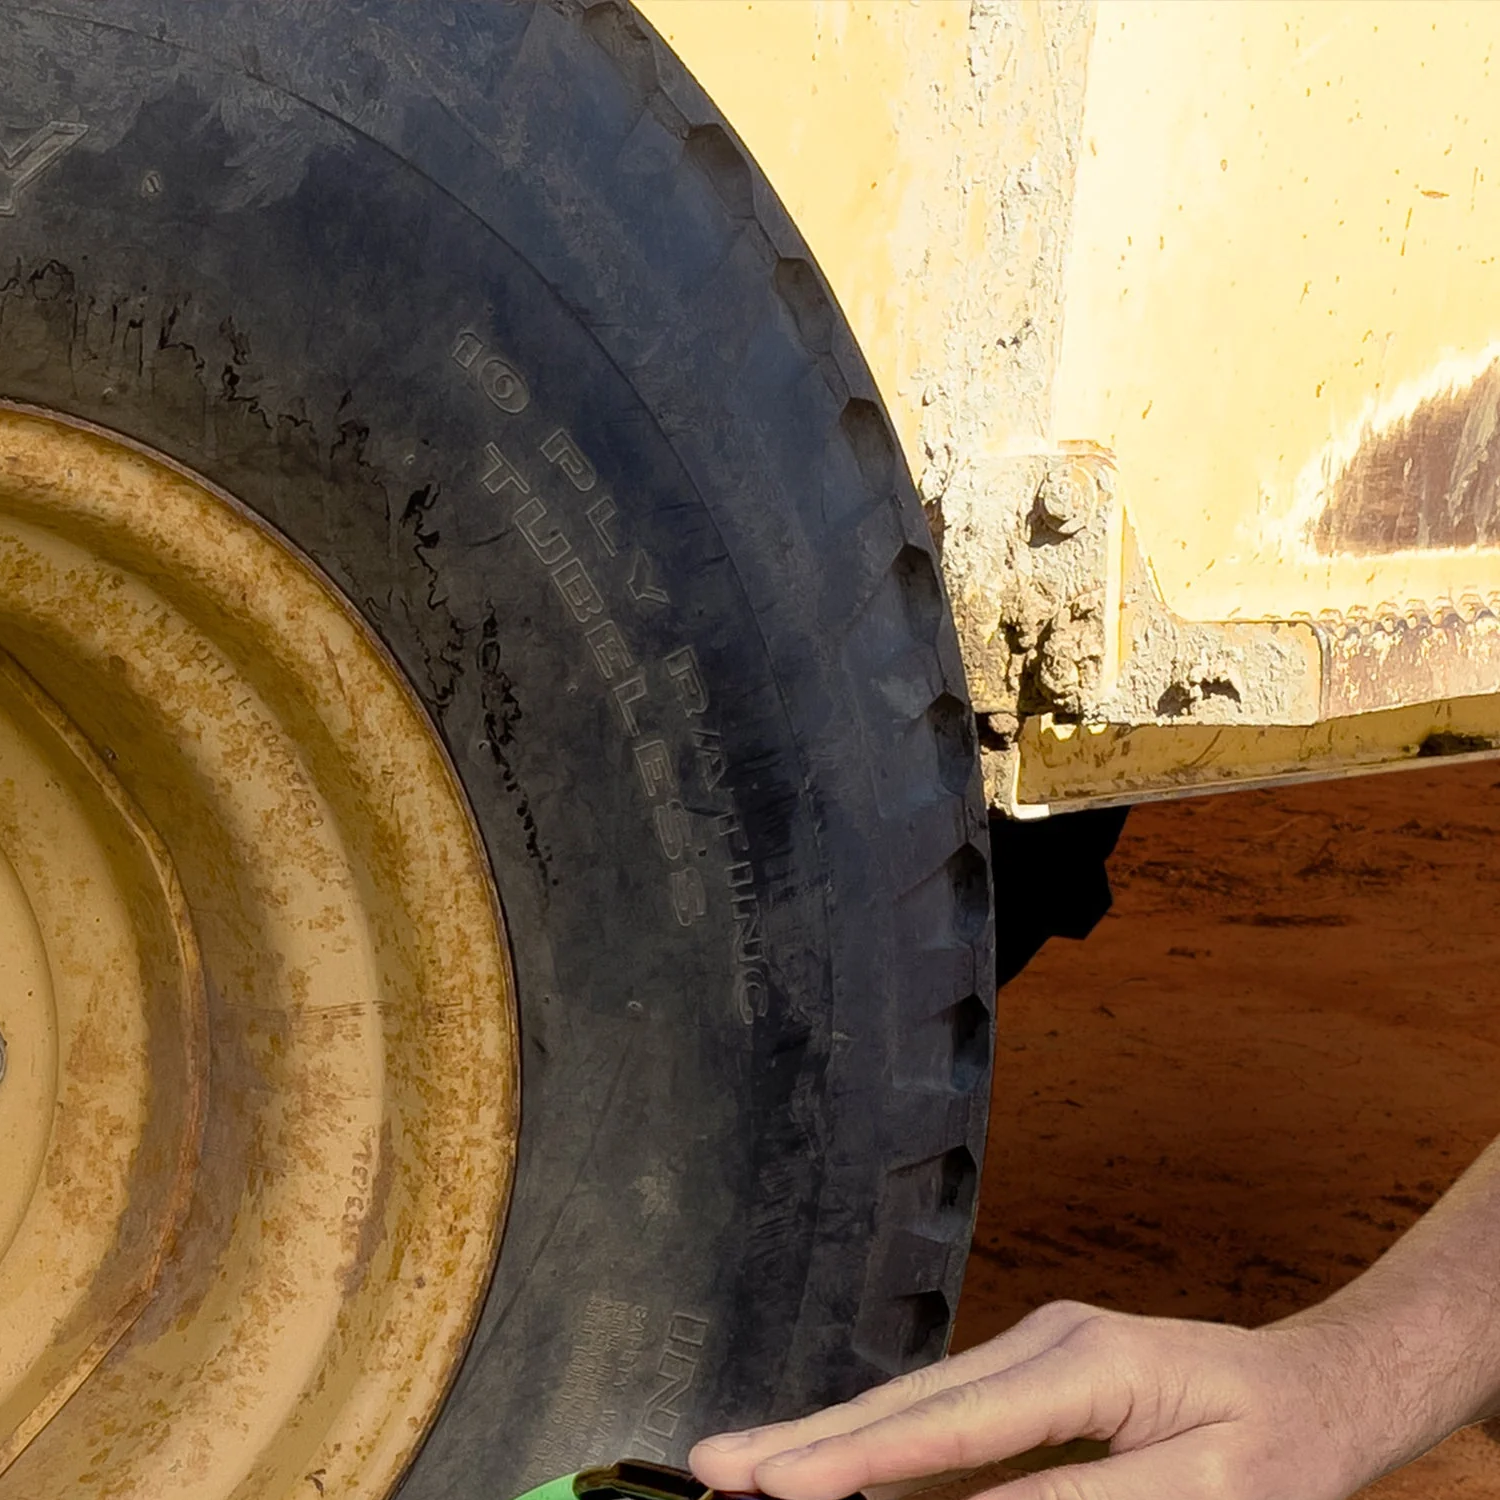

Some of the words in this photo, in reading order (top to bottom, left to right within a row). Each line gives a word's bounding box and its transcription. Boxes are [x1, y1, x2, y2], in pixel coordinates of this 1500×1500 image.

[451, 331, 531, 414] 10
[539, 428, 670, 605] PLY
[480, 441, 706, 927] TUBELESS
